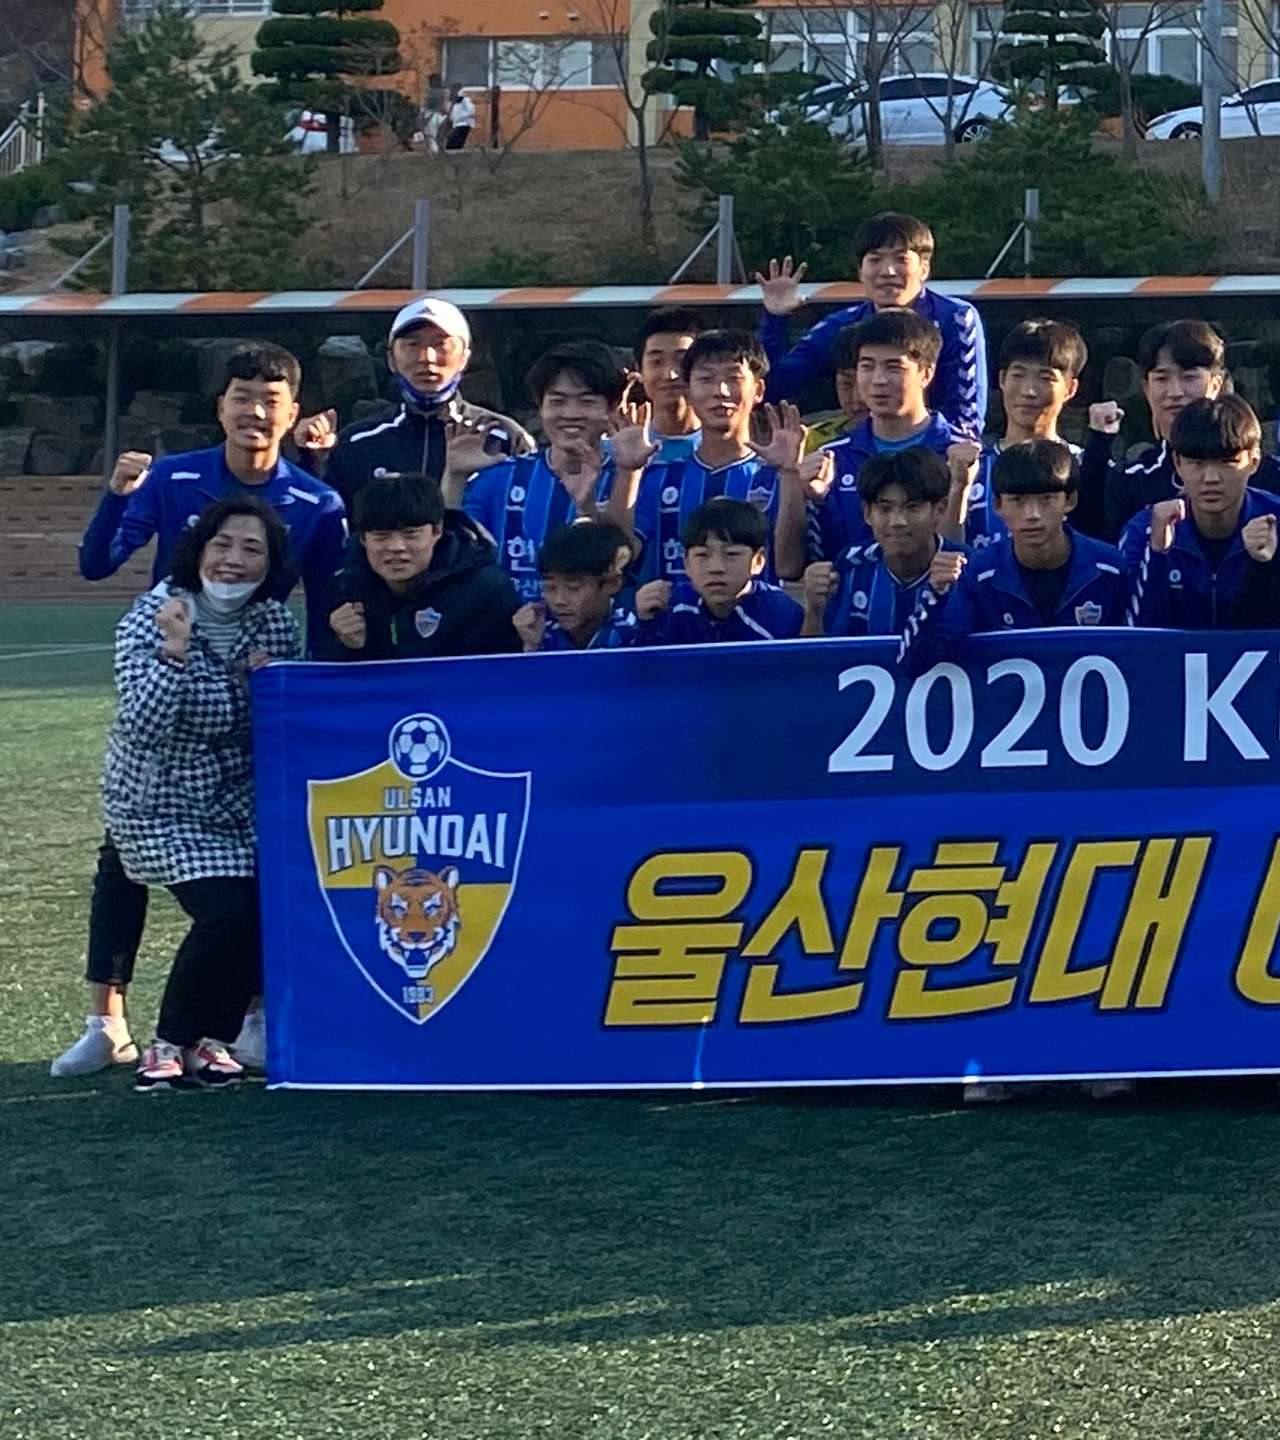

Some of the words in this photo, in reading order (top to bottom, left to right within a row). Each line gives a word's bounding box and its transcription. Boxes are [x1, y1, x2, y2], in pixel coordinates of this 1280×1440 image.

[828, 655, 1129, 773] 2020
[384, 786, 451, 809] ULSAN
[327, 812, 507, 877] HYUNDAI
[603, 836, 1211, 1028] 울산현대
